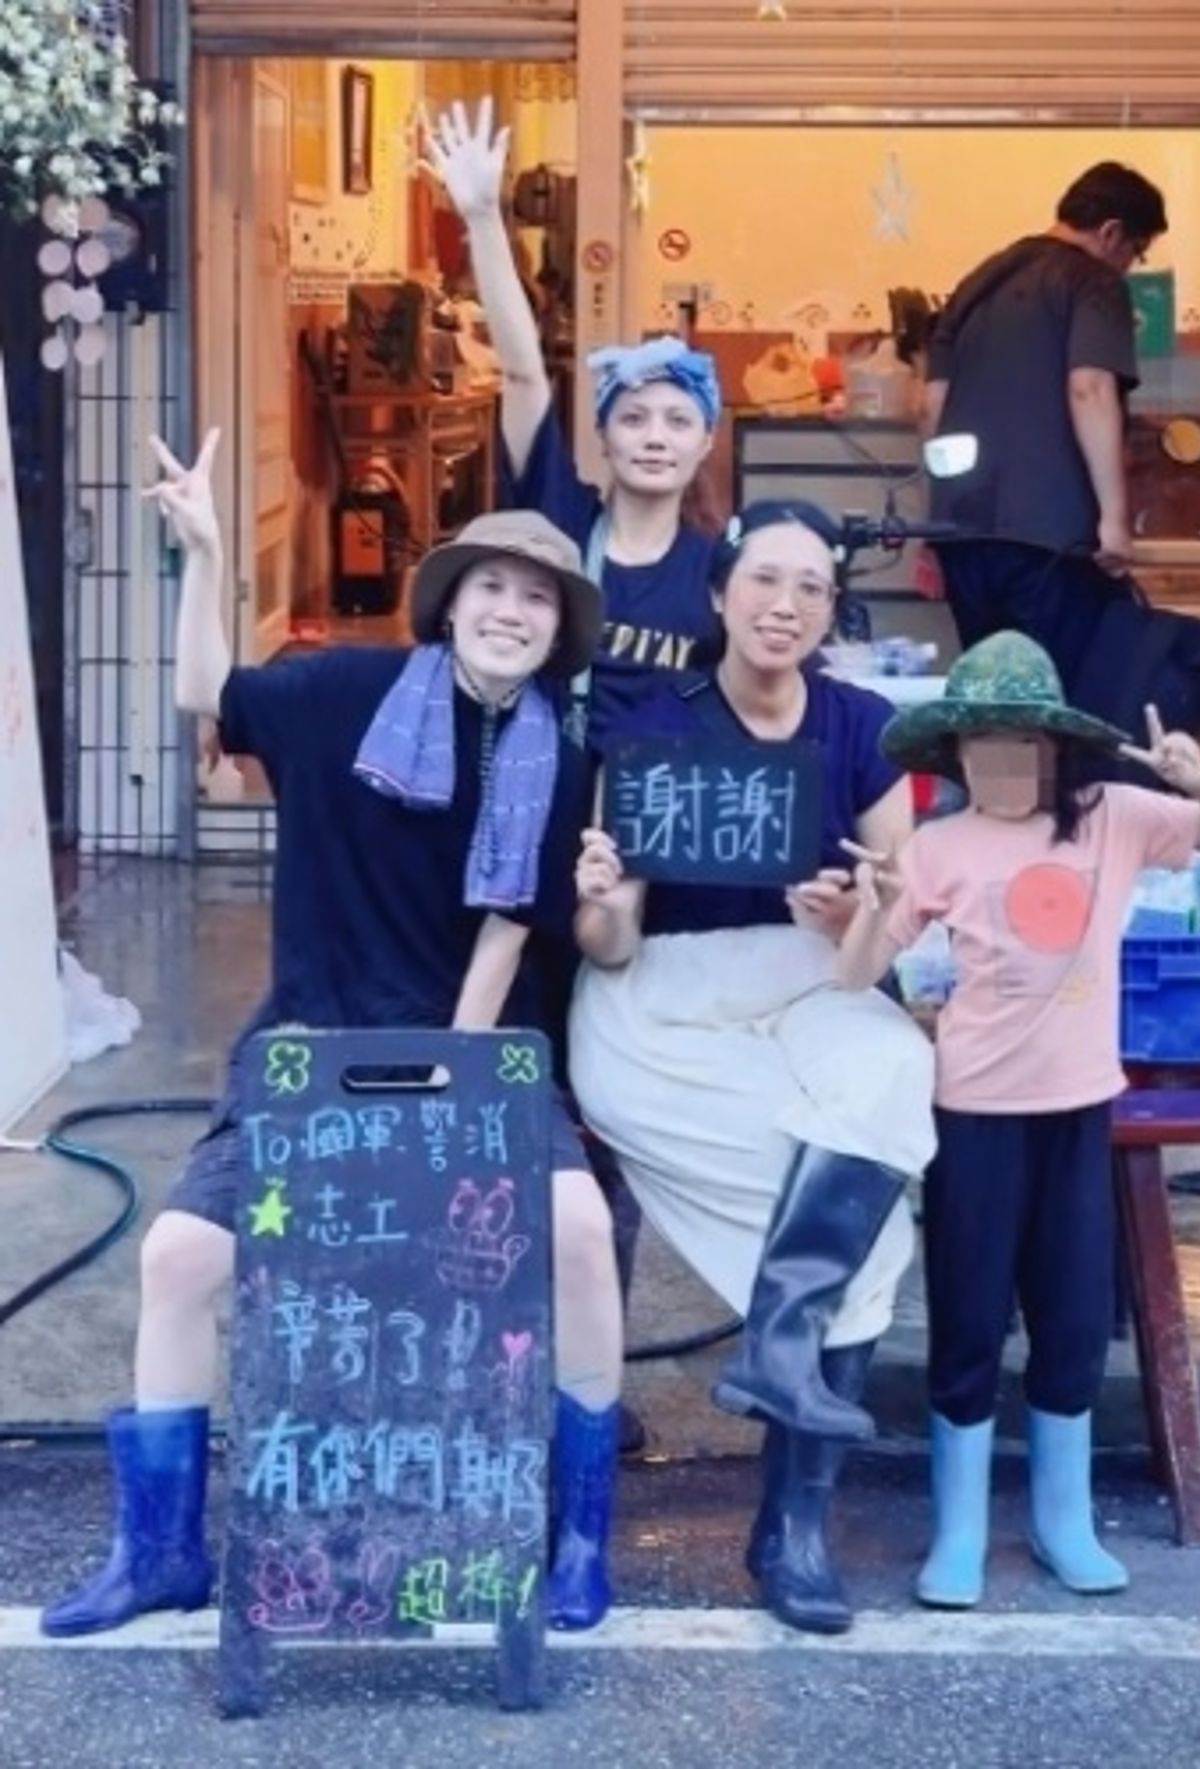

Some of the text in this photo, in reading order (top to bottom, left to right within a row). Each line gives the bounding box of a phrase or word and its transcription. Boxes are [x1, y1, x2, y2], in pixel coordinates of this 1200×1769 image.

[615, 763, 795, 862] 謝謝
[308, 1184, 408, 1246] 志工
[246, 1410, 549, 1547] 有你們真好
